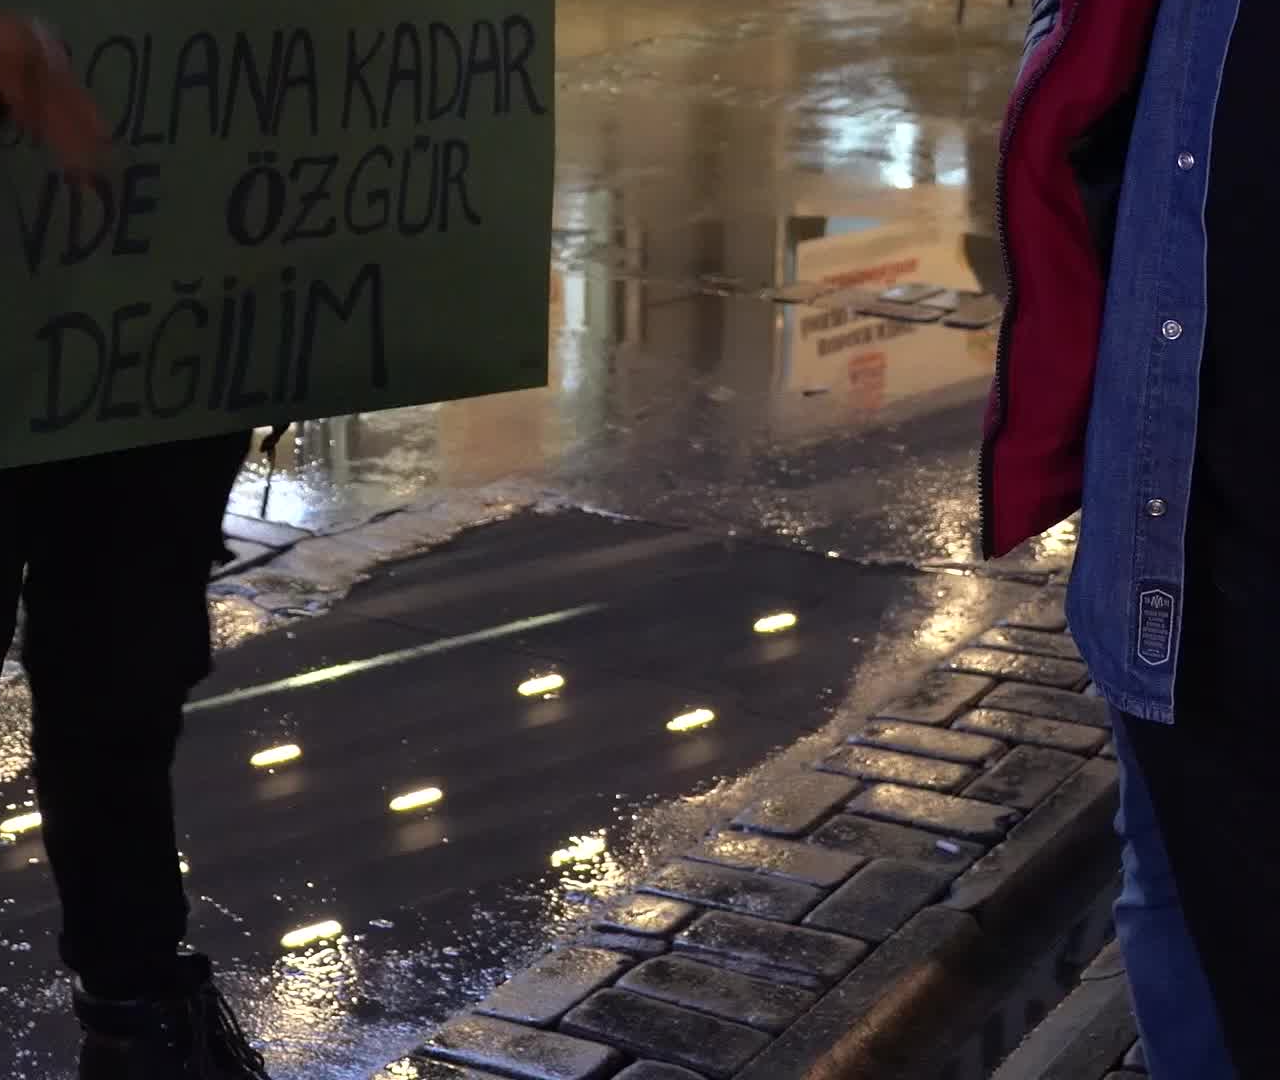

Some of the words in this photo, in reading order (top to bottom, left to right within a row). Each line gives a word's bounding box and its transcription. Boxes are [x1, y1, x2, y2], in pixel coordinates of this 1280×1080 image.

[342, 13, 546, 130] KADAR
[227, 139, 482, 247] ÖZGÜR
[29, 262, 388, 433] DEĞİLİM
